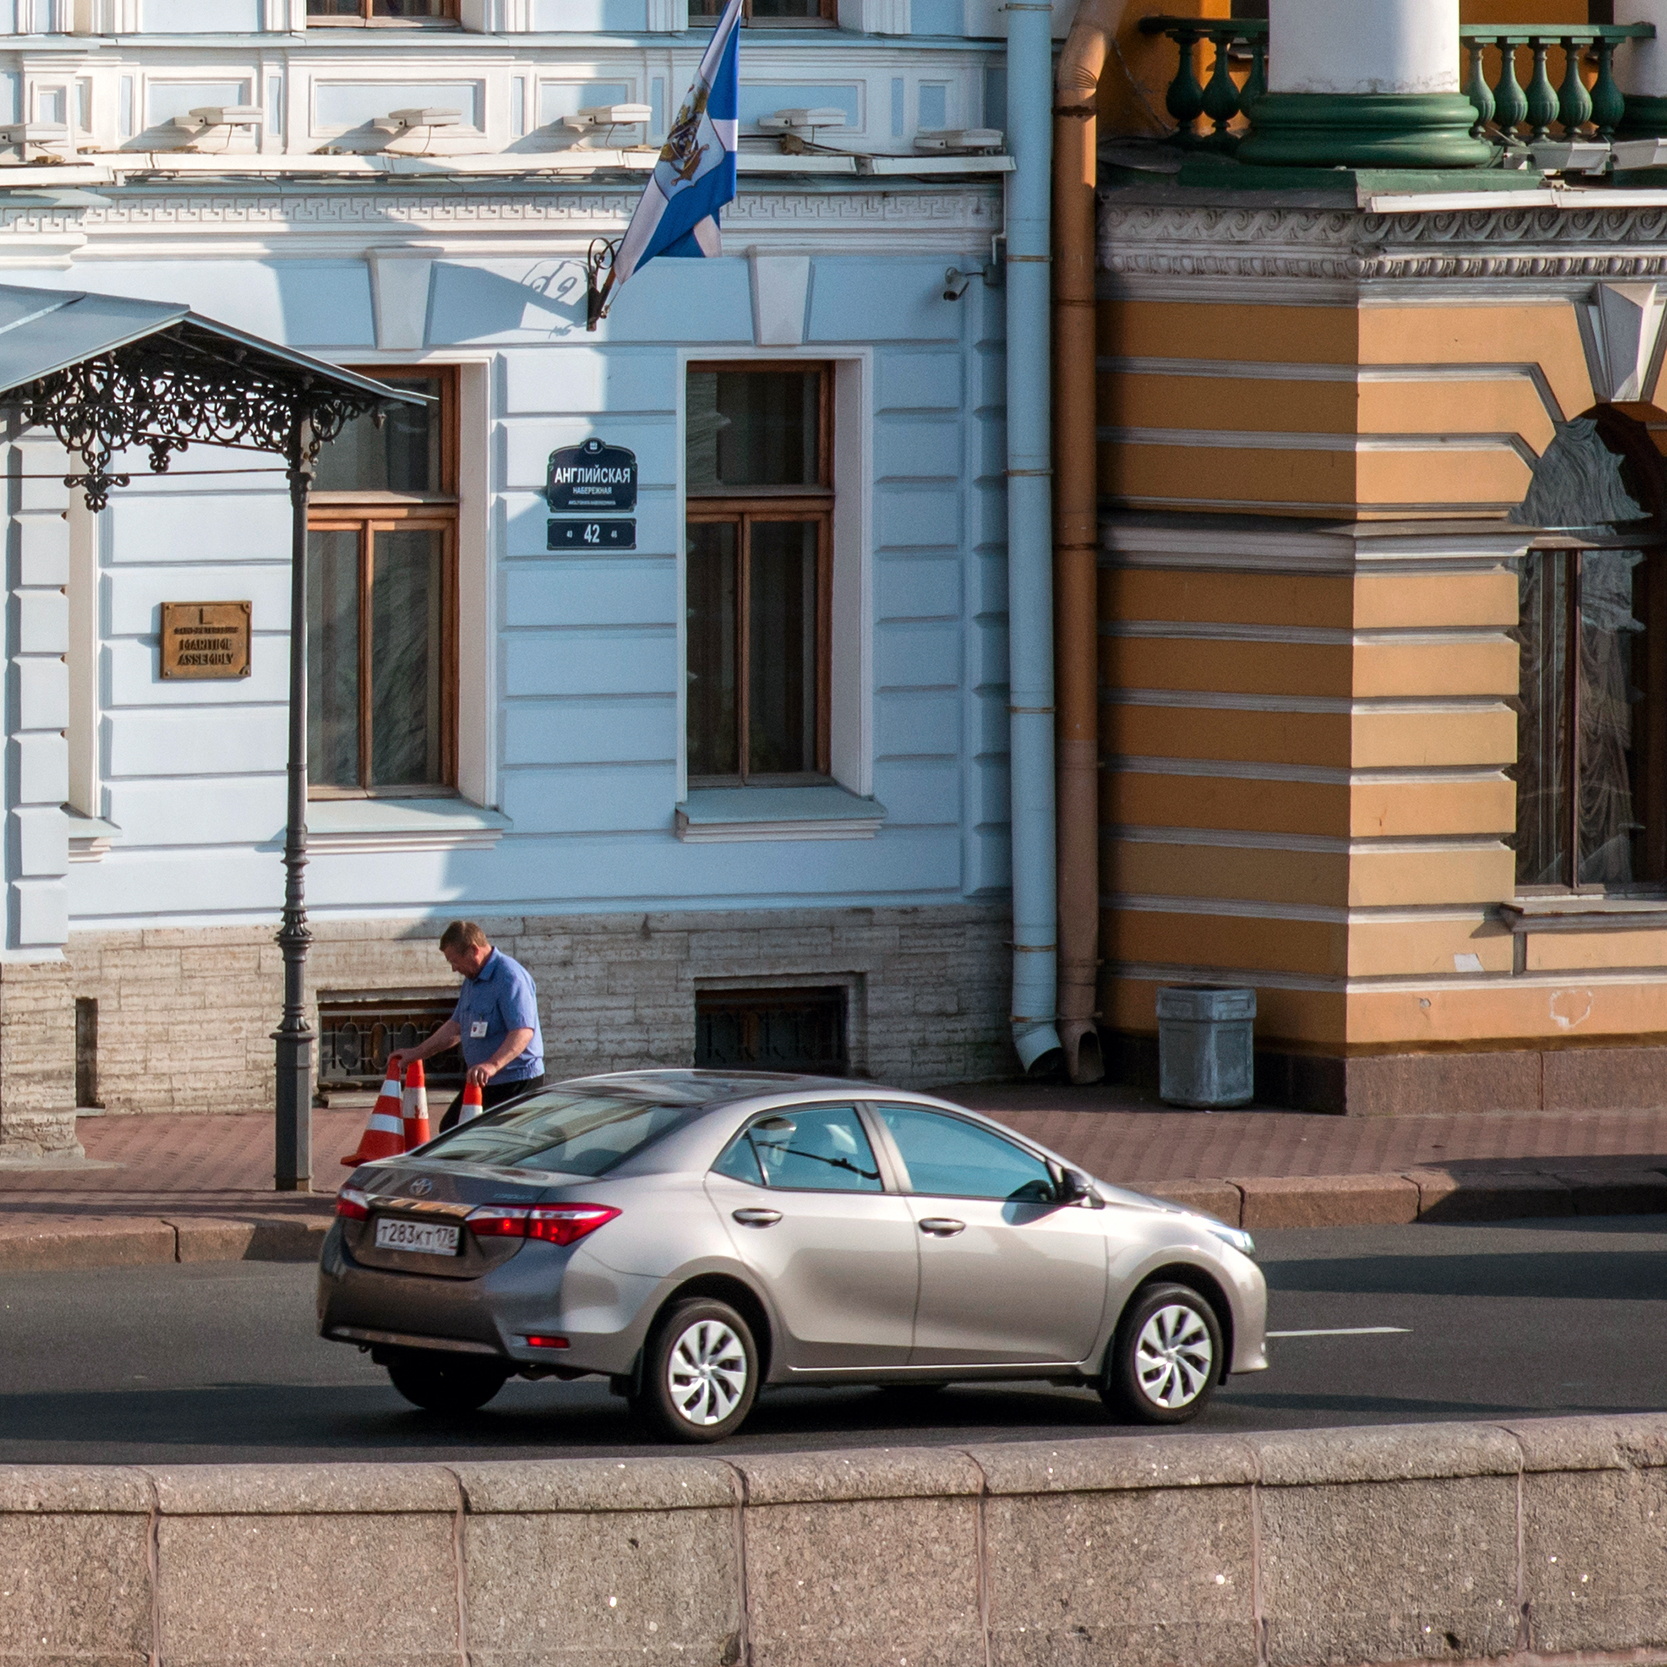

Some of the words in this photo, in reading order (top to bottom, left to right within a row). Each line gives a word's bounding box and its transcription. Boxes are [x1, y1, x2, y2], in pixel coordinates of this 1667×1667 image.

[554, 464, 631, 484] АНГЛИЙСКАЯ
[572, 486, 613, 495] НАБЕРЕЖНАЯ
[584, 524, 600, 543] 42
[176, 653, 234, 666] ASSEMBLY
